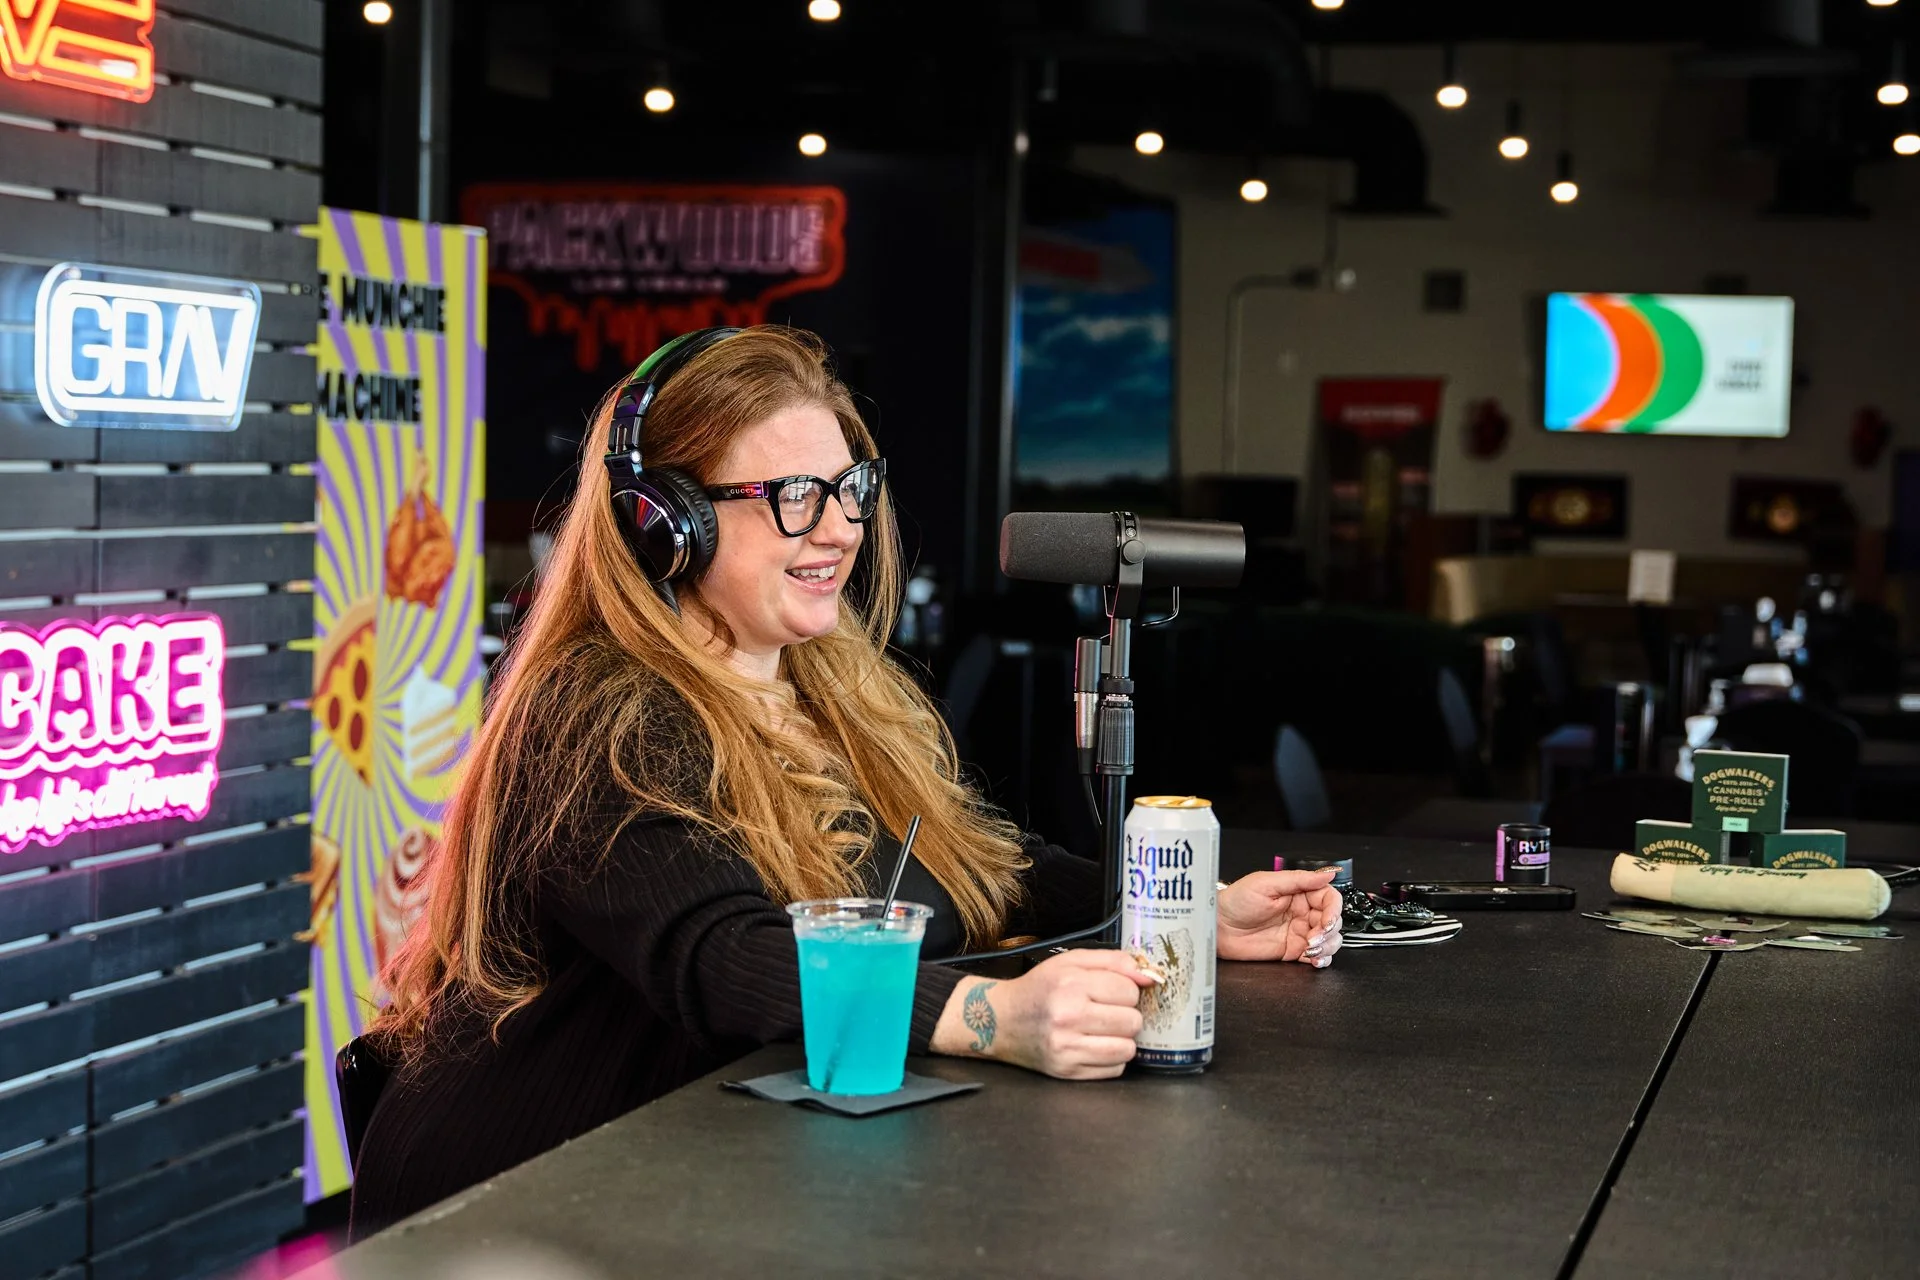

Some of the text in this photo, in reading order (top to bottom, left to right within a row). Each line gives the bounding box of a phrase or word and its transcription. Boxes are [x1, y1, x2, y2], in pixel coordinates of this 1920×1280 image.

[342, 274, 446, 333] MUNCHIE
[50, 291, 258, 403] GRAV
[1709, 795, 1766, 806] PRE-ROLLS
[1713, 786, 1763, 797] CANNABIS
[1126, 833, 1193, 875] Liquid
[1642, 839, 1711, 861] DOGWALKERS
[1128, 868, 1193, 901] Death
[1700, 864, 1733, 875] Enjoy
[1757, 869, 1808, 880] Journey
